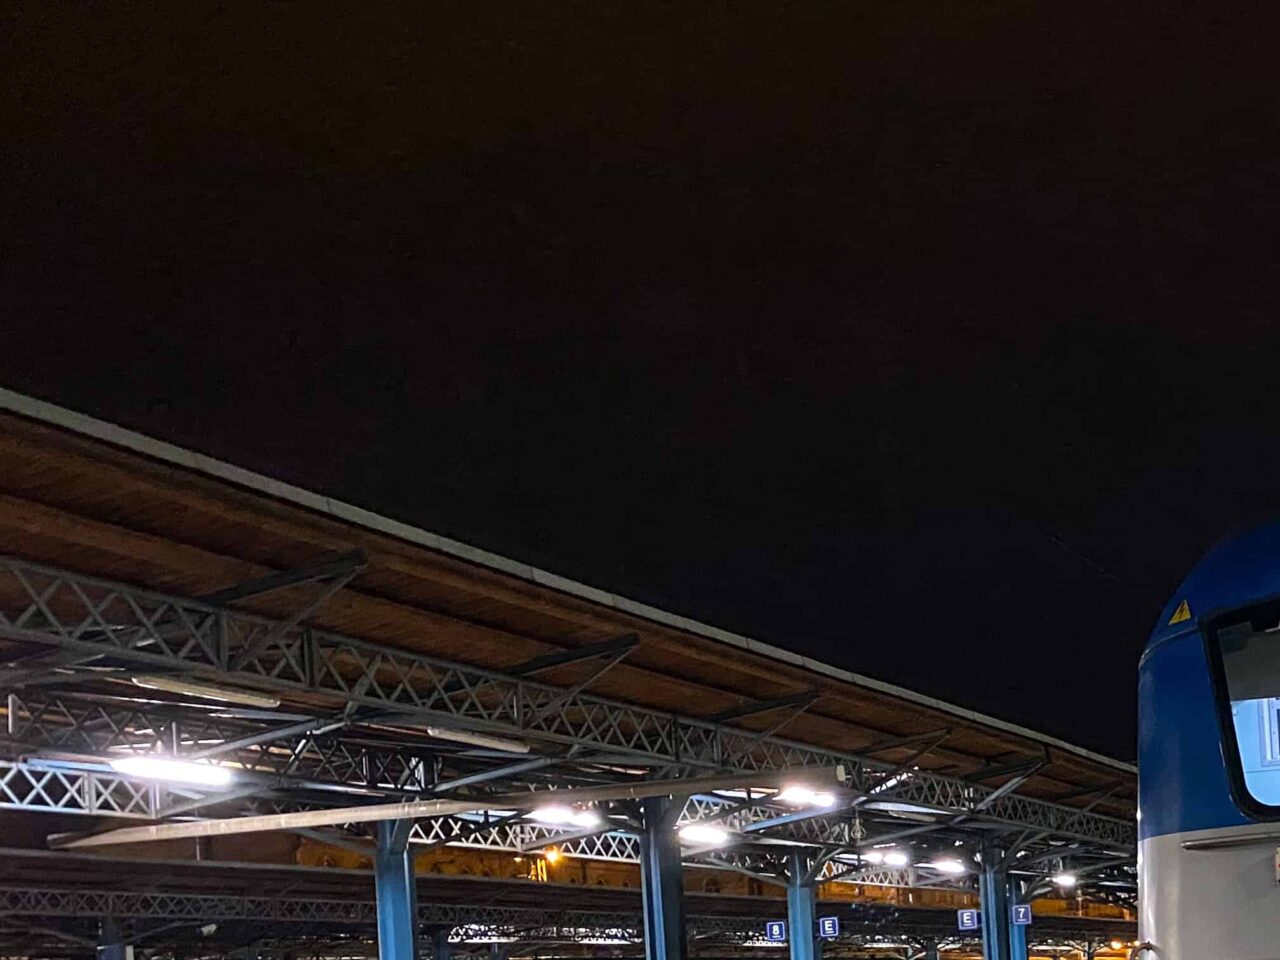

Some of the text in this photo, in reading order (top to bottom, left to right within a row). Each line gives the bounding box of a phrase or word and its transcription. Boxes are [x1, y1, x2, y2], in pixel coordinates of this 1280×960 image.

[963, 912, 972, 924] E
[1017, 908, 1026, 919] 7
[772, 924, 780, 936] 8
[824, 920, 833, 931] E
